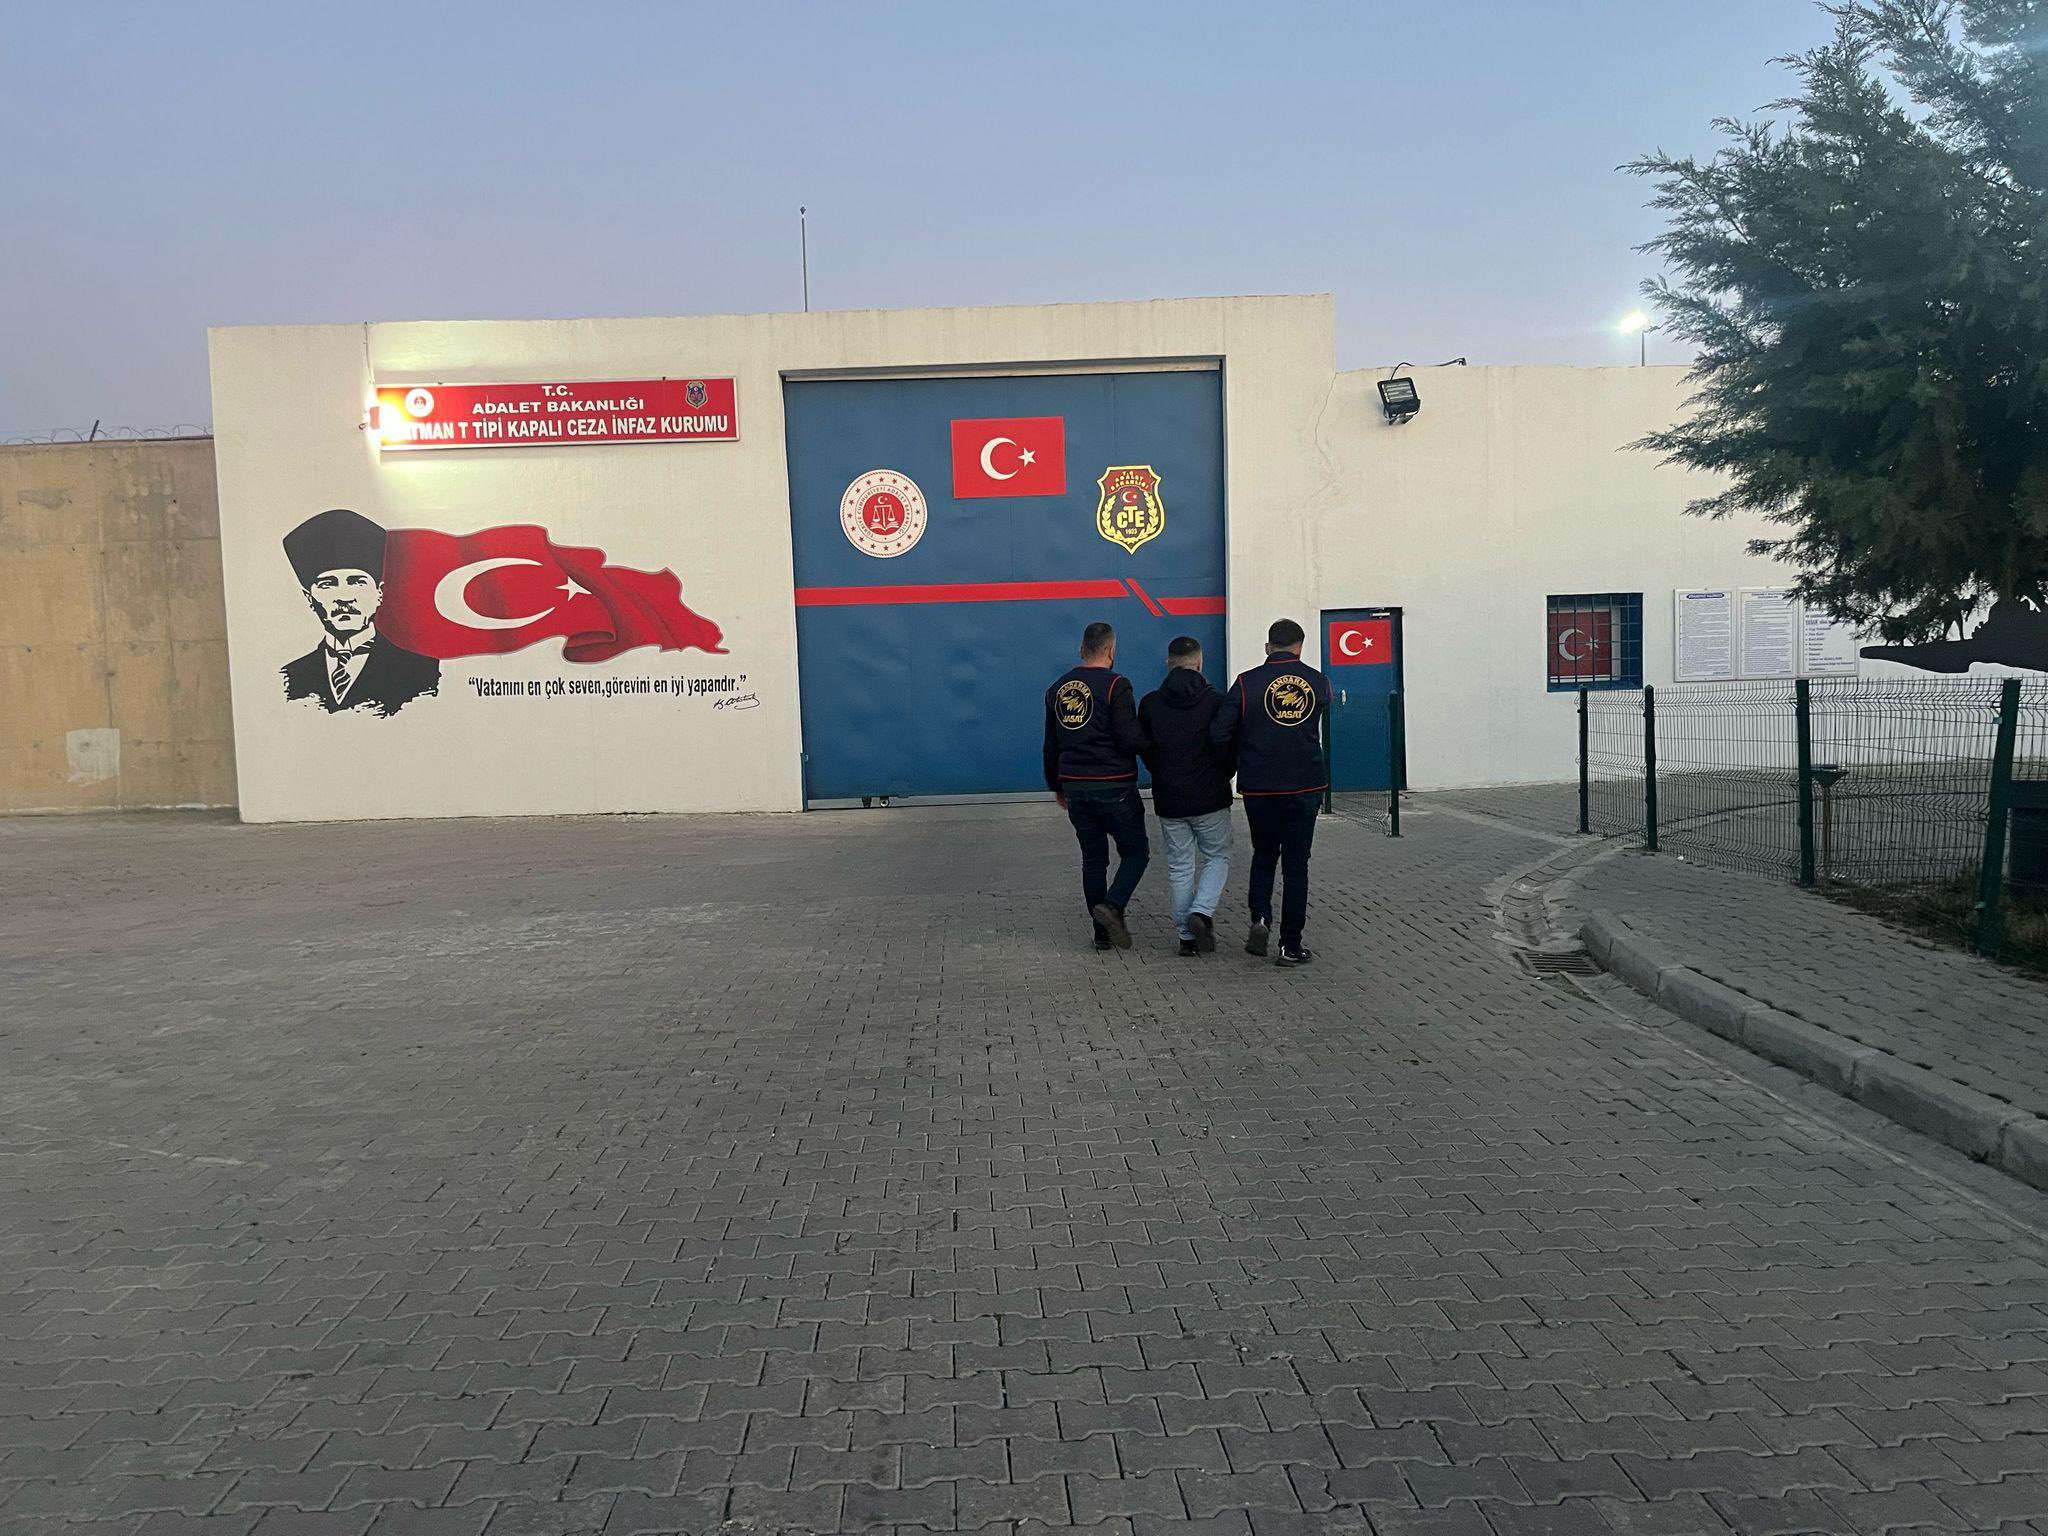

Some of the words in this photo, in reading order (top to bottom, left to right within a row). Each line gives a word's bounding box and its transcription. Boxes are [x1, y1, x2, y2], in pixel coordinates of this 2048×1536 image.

[542, 385, 573, 397] T.C.
[472, 401, 541, 415] ADALET
[547, 396, 644, 413] BAKANLIĞI
[458, 421, 468, 439] T
[472, 417, 503, 439] TİPİ
[507, 419, 562, 438] KAPALI
[567, 418, 608, 436] CEZA
[612, 414, 657, 435] İNFAZ
[661, 415, 729, 434] KURUMU
[1116, 505, 1145, 529] CTE
[527, 680, 541, 696] en
[545, 677, 566, 699] çok
[653, 679, 668, 693] en
[671, 676, 684, 697] iyi
[1270, 676, 1311, 694] JANDARMA
[1062, 715, 1083, 723] JASAT
[1275, 710, 1302, 719] JASAT
